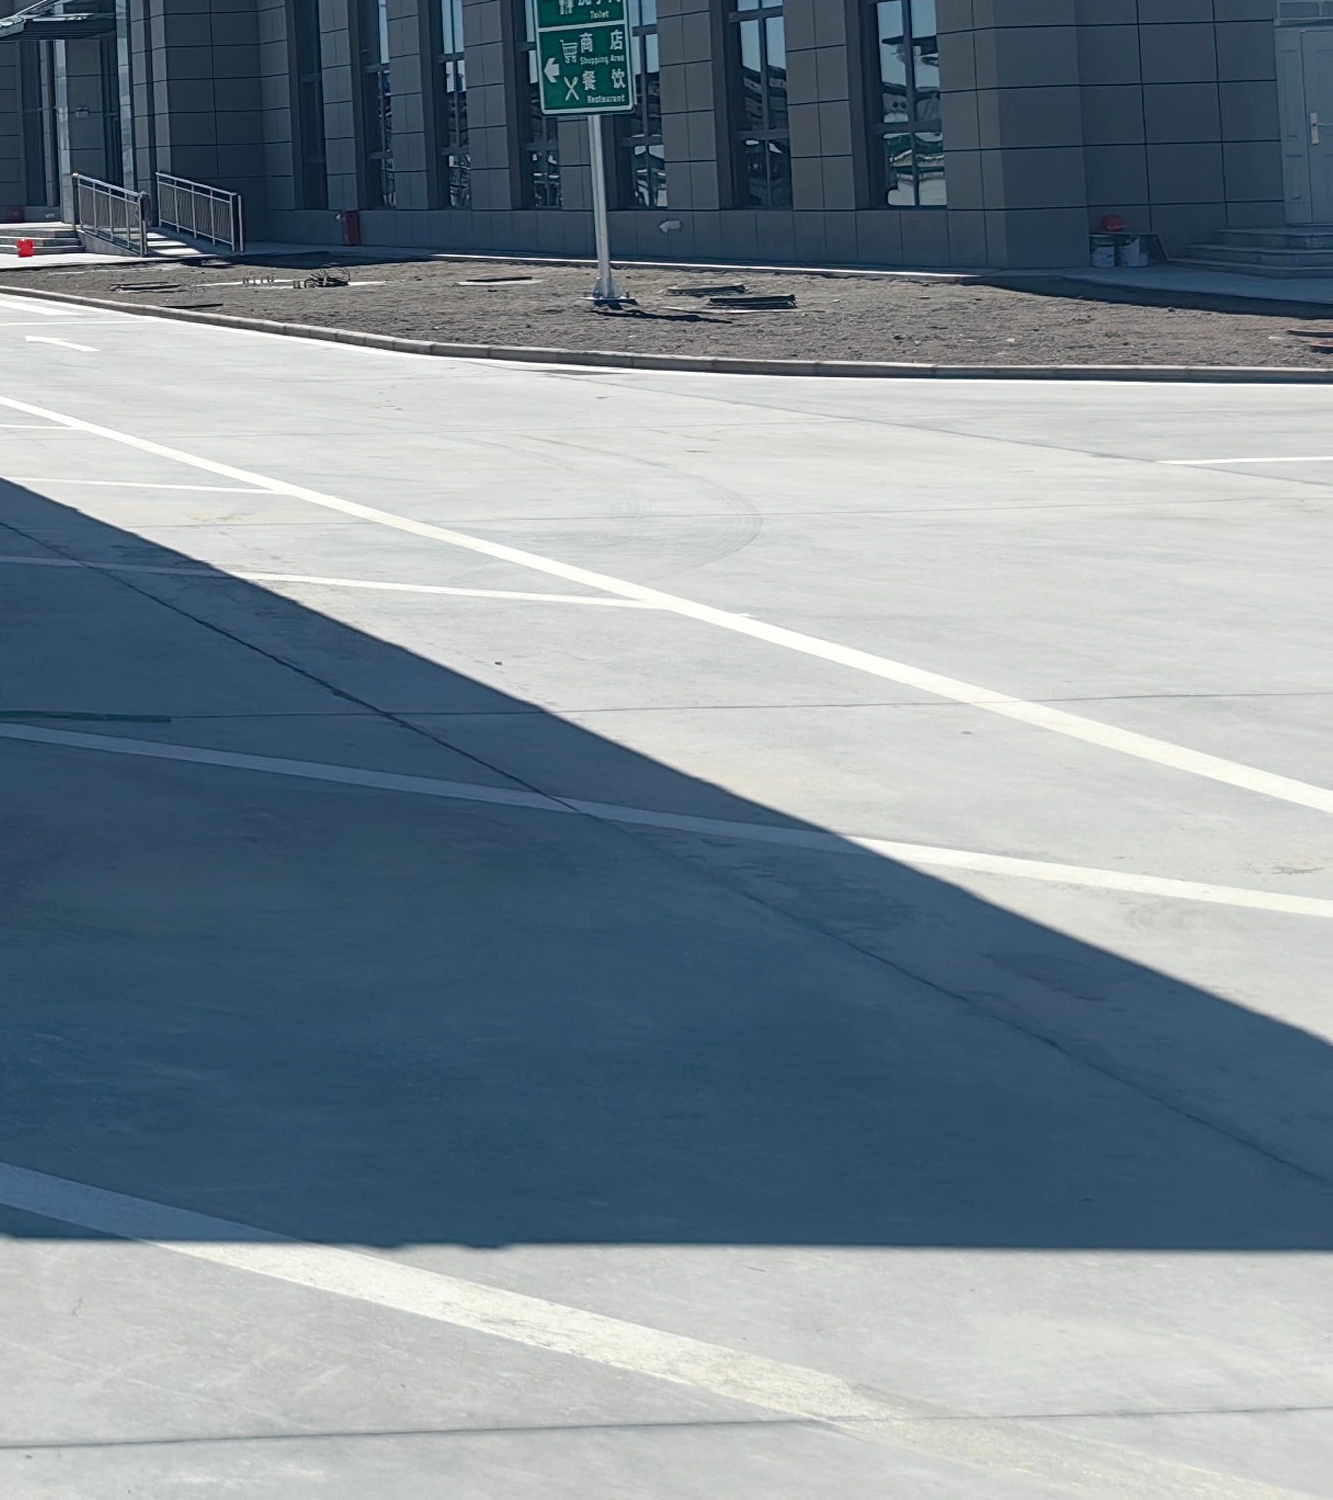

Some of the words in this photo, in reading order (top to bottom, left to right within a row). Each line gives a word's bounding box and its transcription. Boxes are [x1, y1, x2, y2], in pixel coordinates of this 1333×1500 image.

[590, 10, 610, 19] Toilet
[580, 56, 609, 66] Shopping
[610, 54, 625, 62] Area
[587, 94, 626, 104] Restaurant
